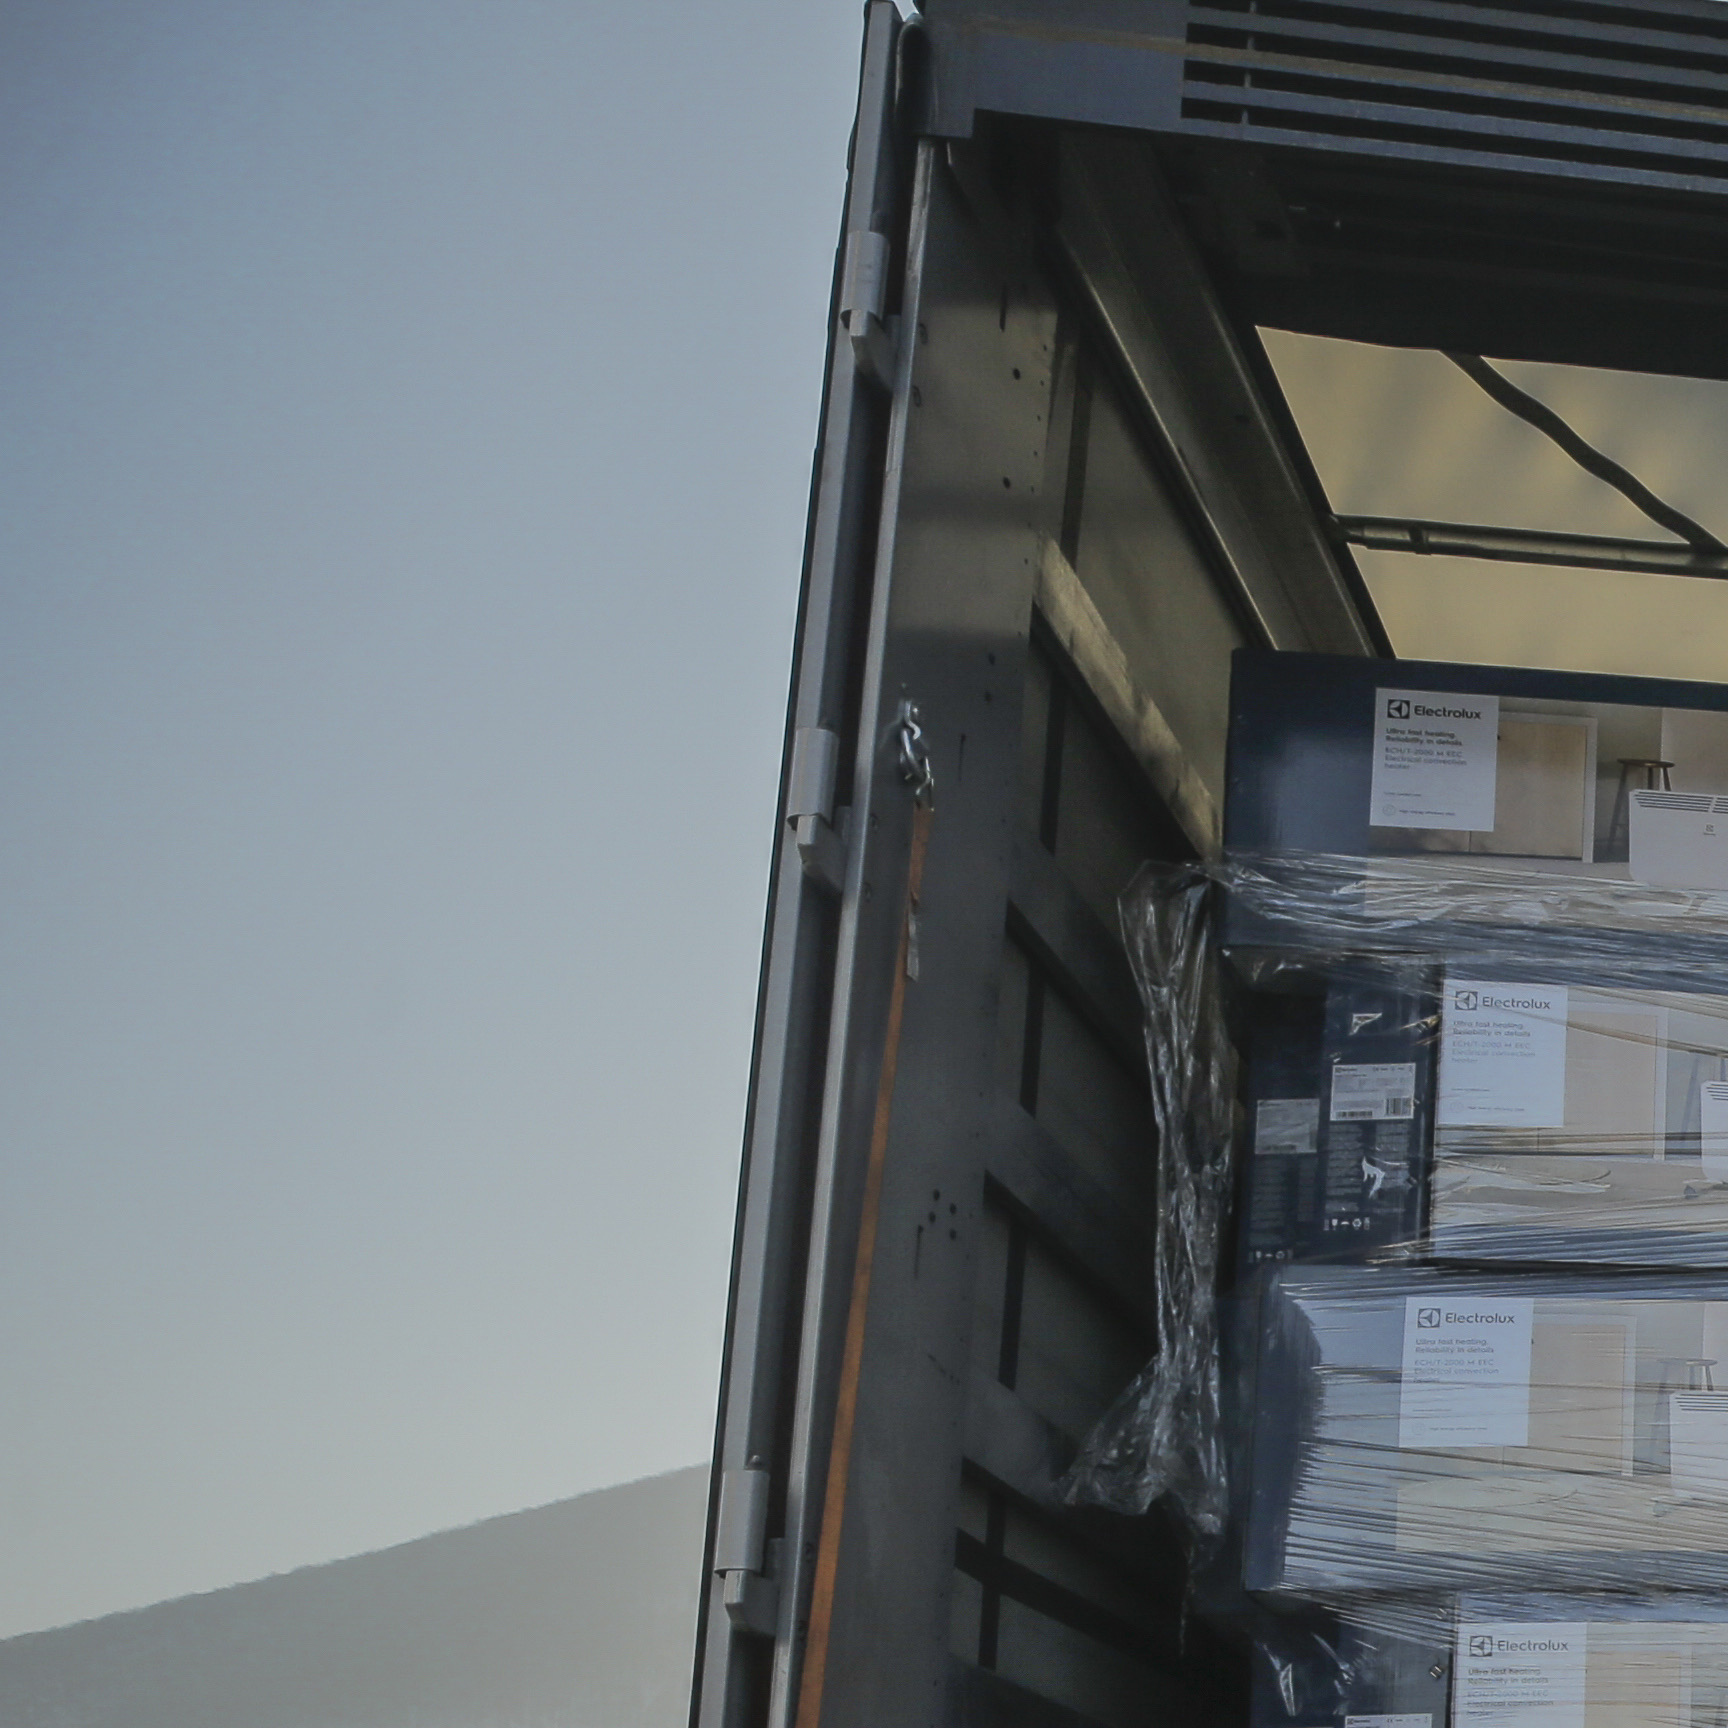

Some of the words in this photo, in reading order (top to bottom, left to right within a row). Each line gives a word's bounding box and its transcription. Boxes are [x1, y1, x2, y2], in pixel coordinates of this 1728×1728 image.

[1414, 705, 1481, 720] Electrolux
[1482, 996, 1551, 1010] Electrolux
[1445, 1312, 1515, 1324] Electrolux
[1497, 1640, 1569, 1651] Electrolux
